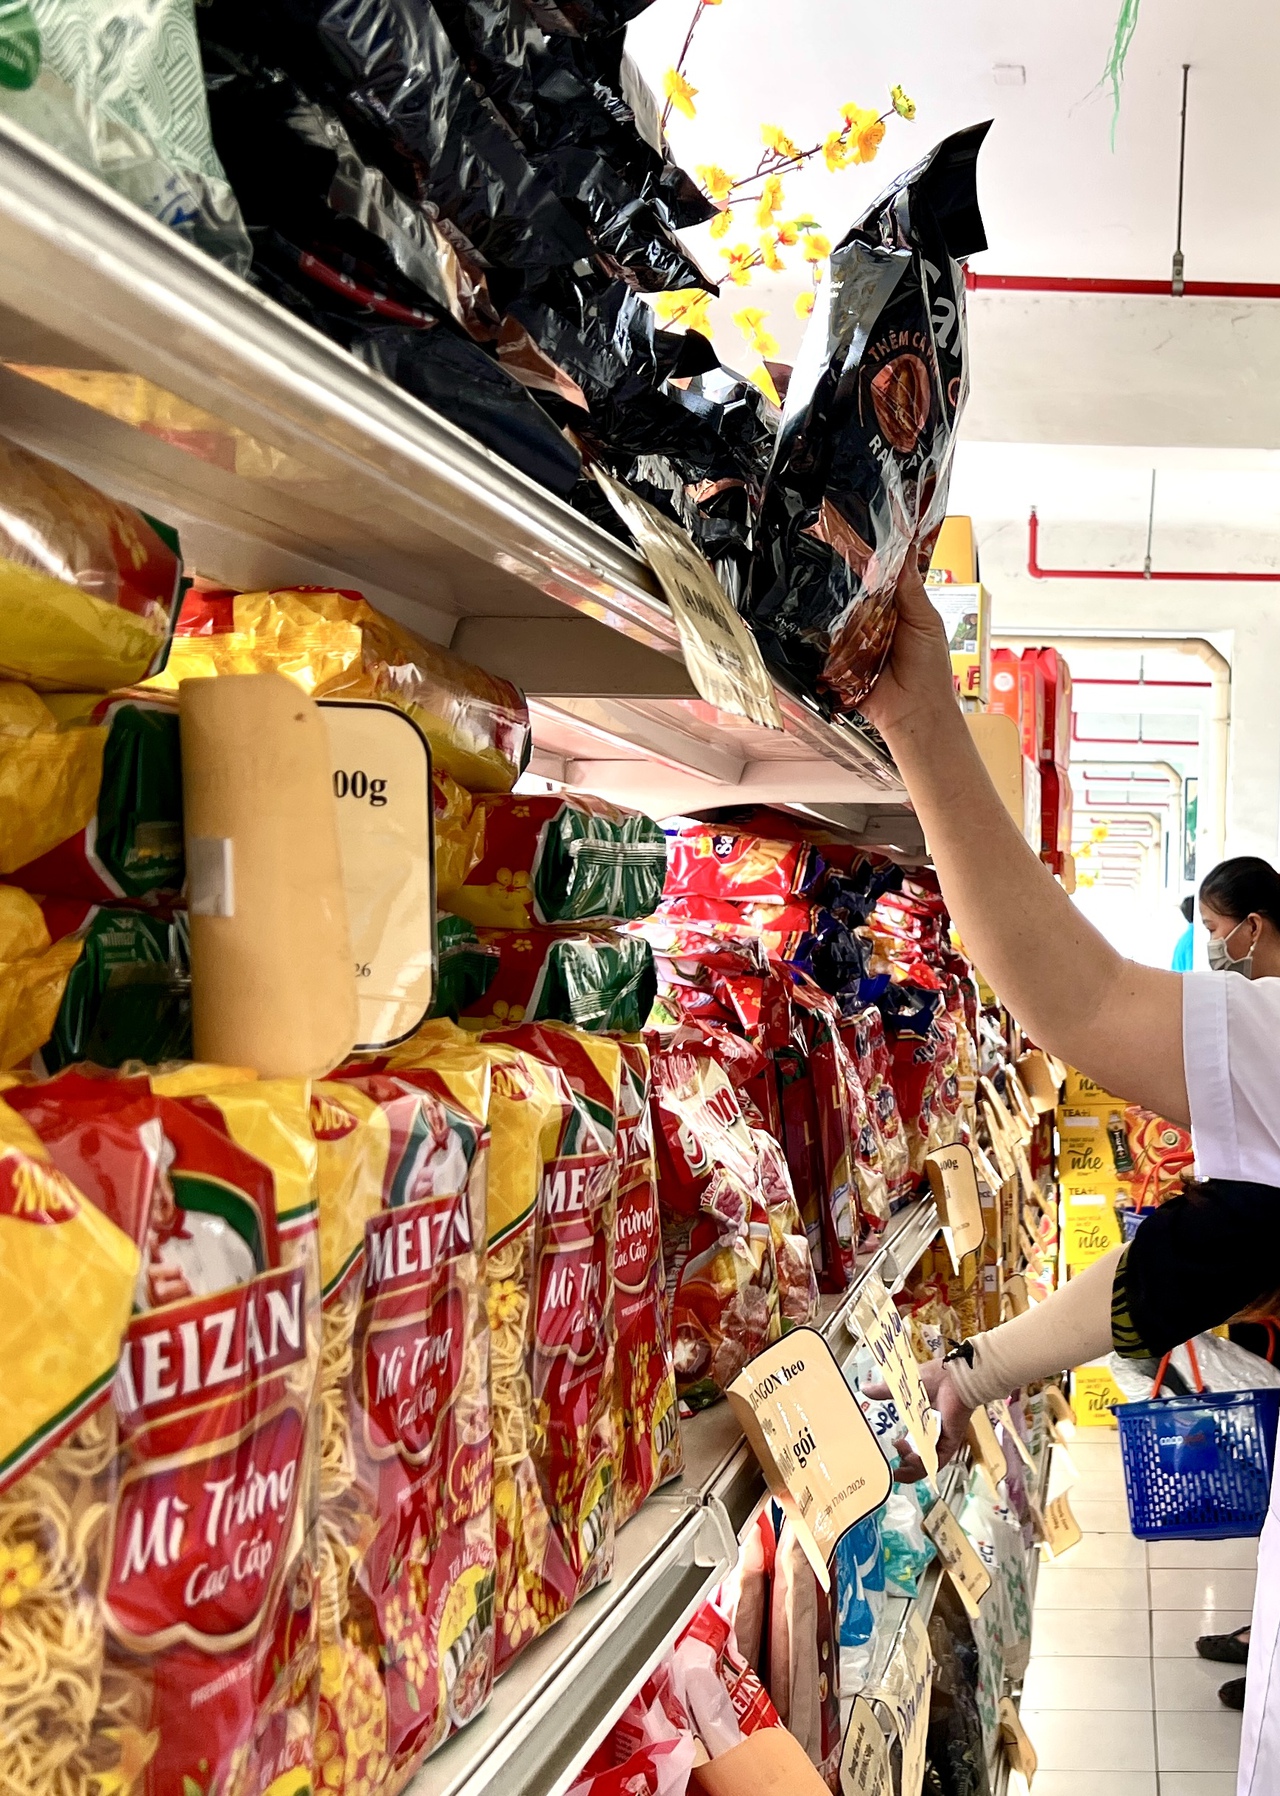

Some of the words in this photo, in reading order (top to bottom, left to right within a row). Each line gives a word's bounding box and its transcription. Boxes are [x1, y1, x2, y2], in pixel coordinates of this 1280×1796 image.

[783, 1359, 805, 1382] heo
[793, 1427, 817, 1469] gói
[119, 1495, 190, 1584] Mì
[202, 1459, 297, 1548] Trứng
[184, 1562, 230, 1607] Cao
[233, 1528, 273, 1582] Cấp
